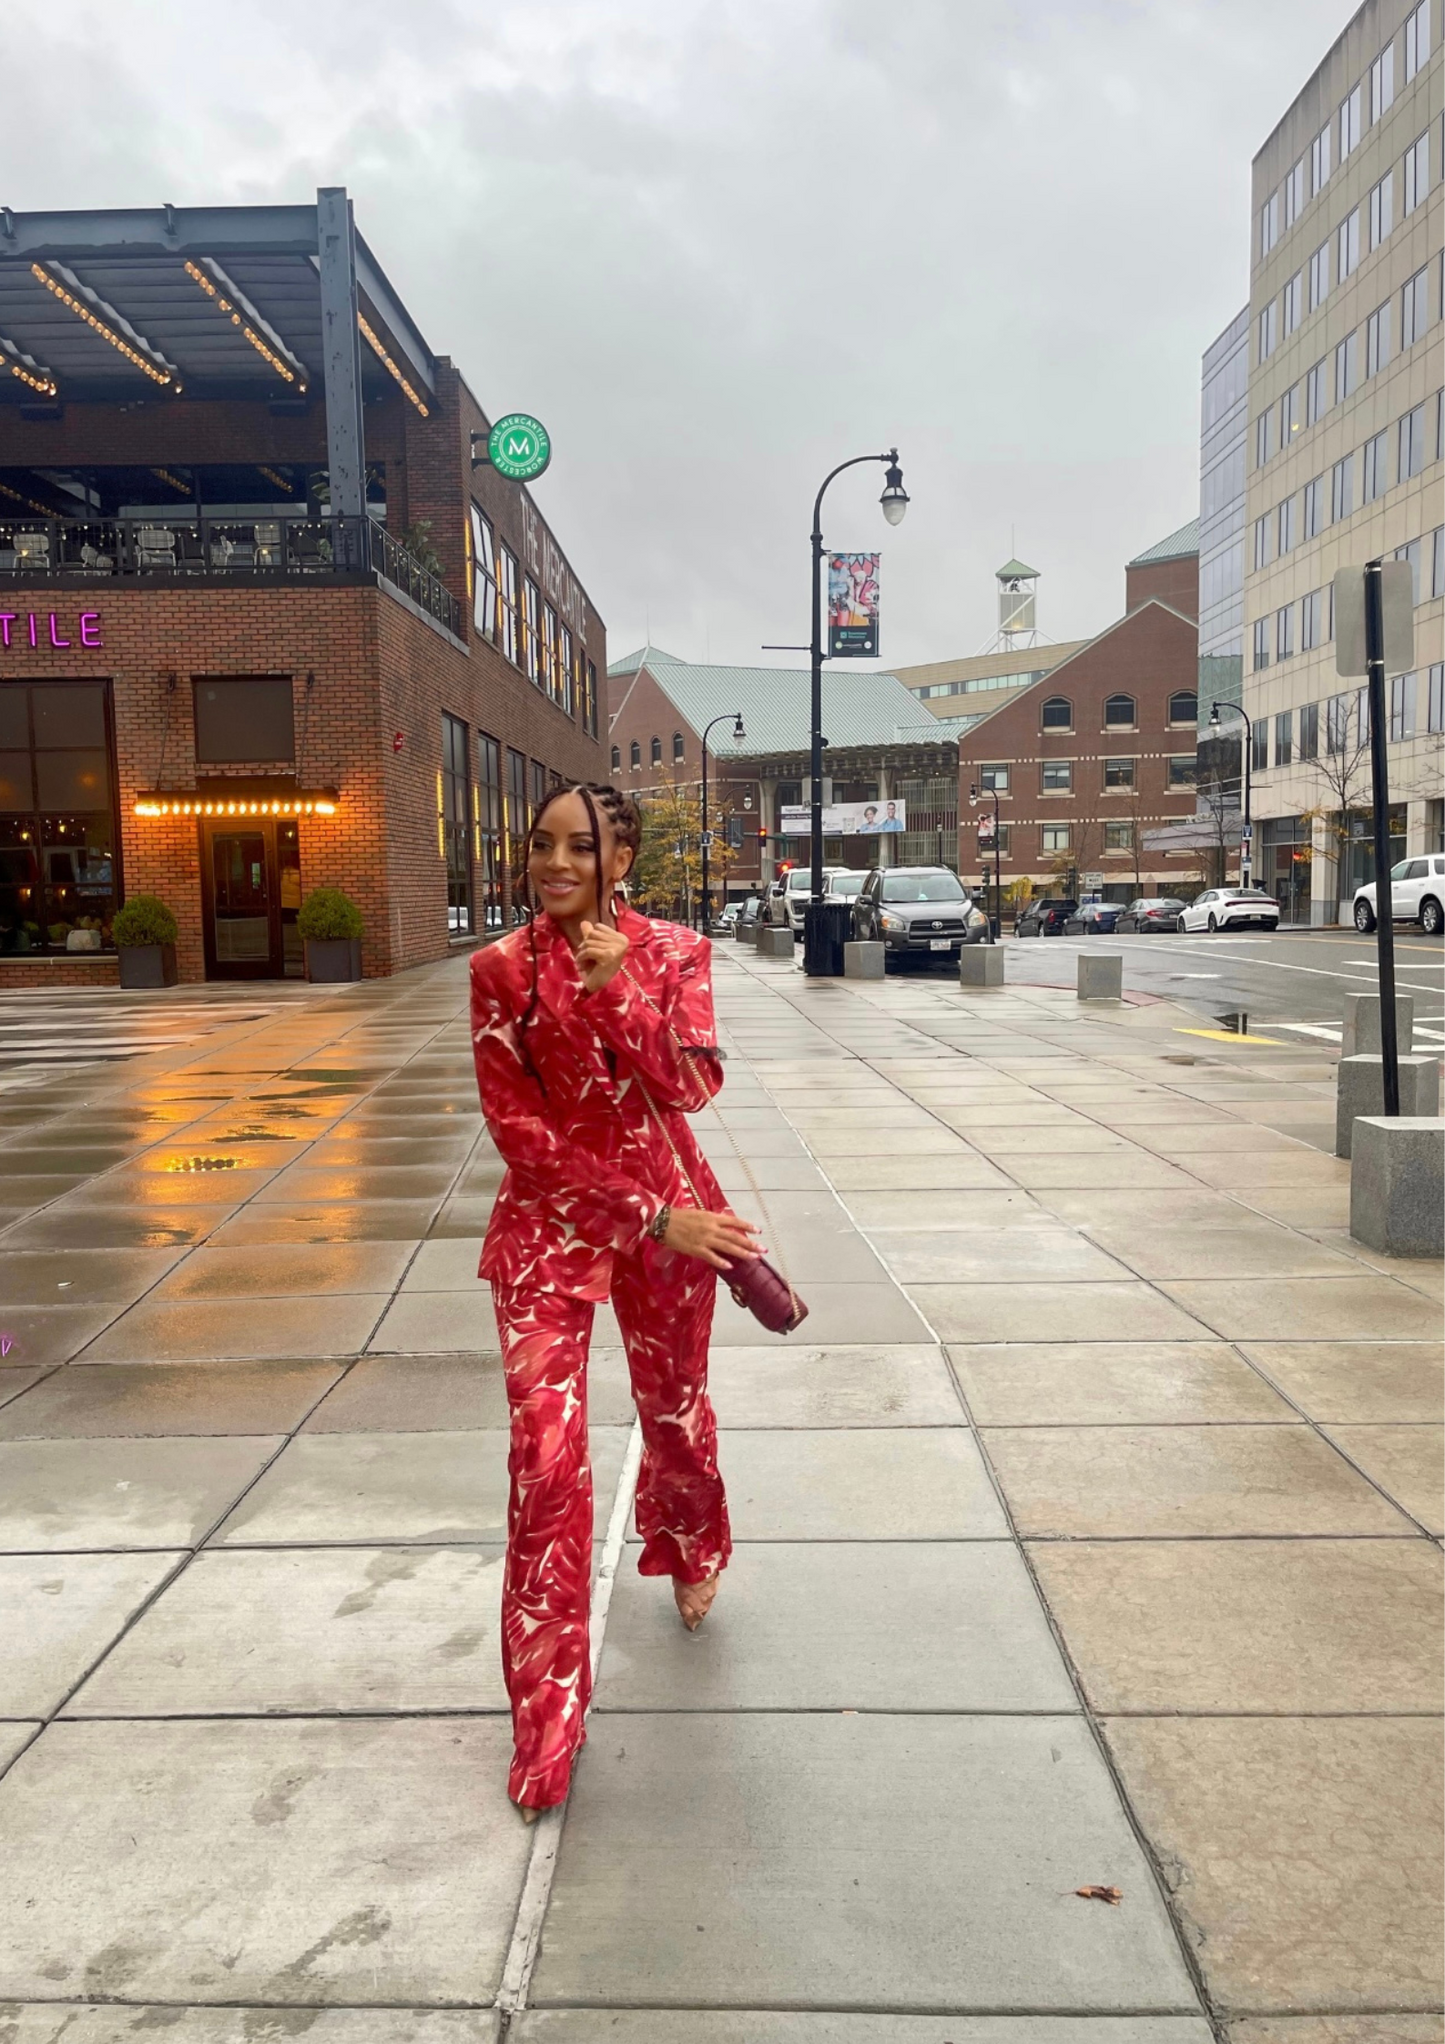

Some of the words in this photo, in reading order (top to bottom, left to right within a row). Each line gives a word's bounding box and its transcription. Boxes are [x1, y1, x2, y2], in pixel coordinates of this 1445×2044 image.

[491, 429, 502, 447] THE
[501, 417, 548, 447] MERCANTILE
[508, 437, 530, 456] M
[495, 456, 544, 476] WORCESTER
[0, 612, 101, 648] TILE
